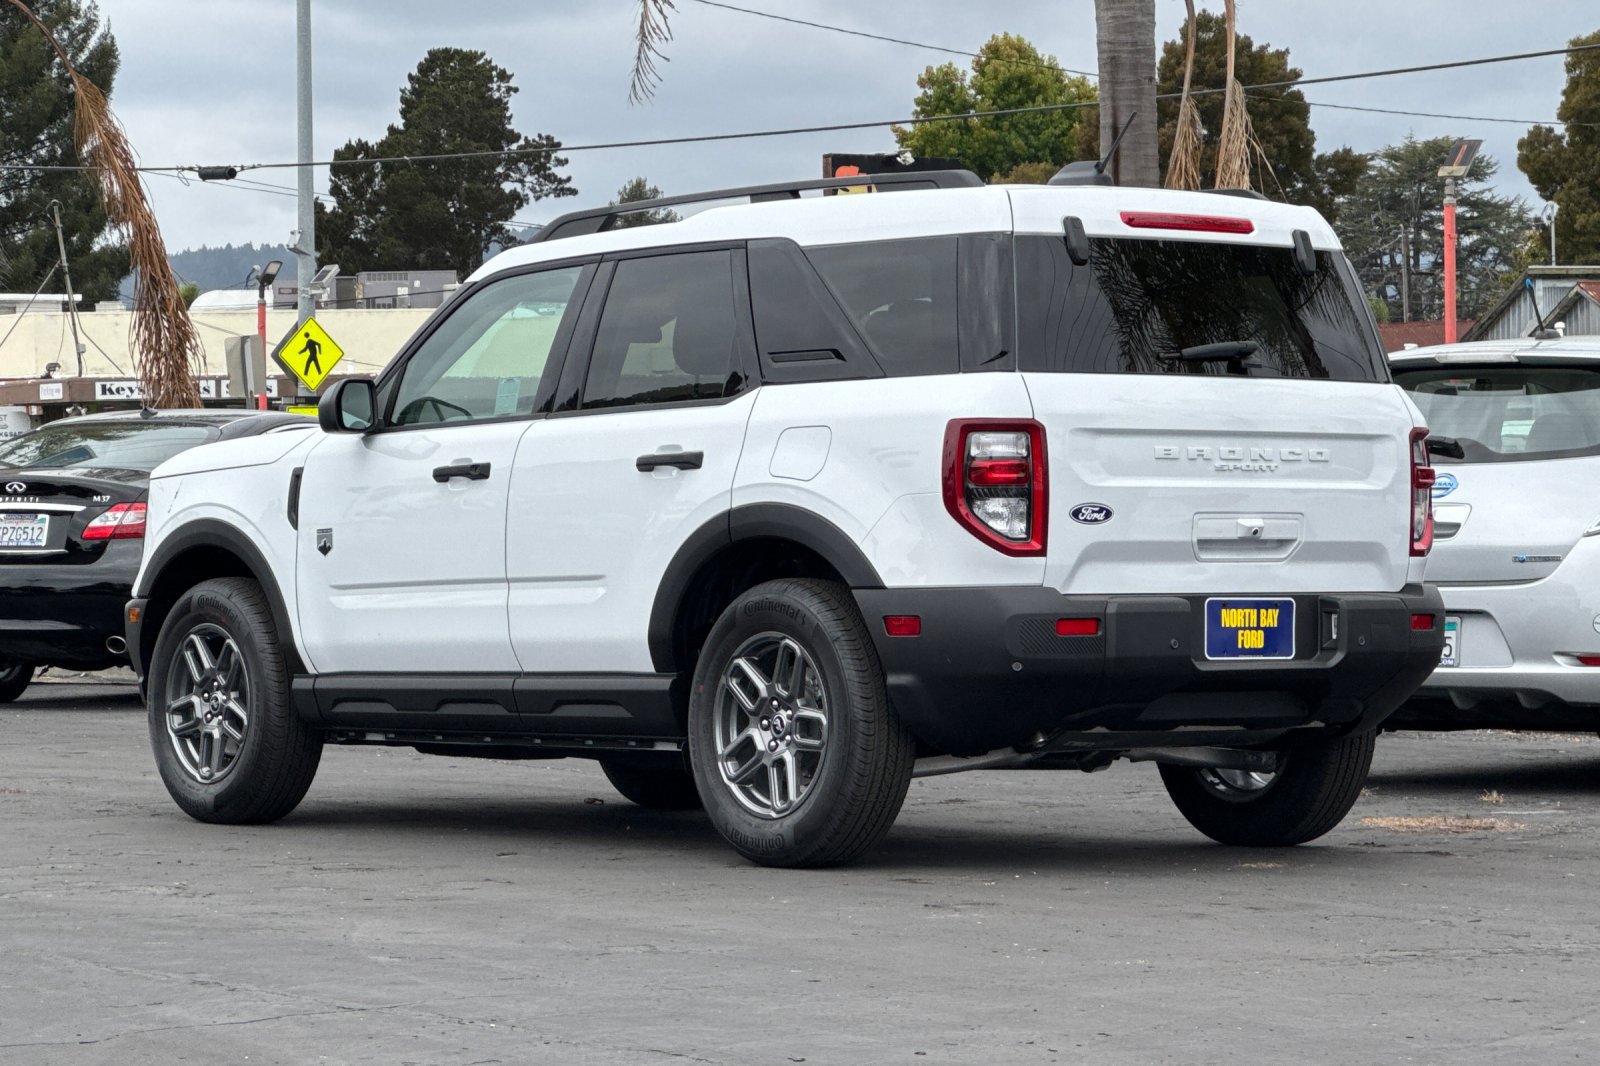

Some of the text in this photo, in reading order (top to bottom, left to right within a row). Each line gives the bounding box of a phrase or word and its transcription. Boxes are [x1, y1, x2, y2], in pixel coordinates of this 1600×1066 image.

[1154, 446, 1330, 462] BRONCO
[1214, 463, 1278, 472] SPORT
[1079, 506, 1106, 520] Ford
[1221, 608, 1279, 628] NORTH BAY
[1237, 629, 1265, 649] FORD
